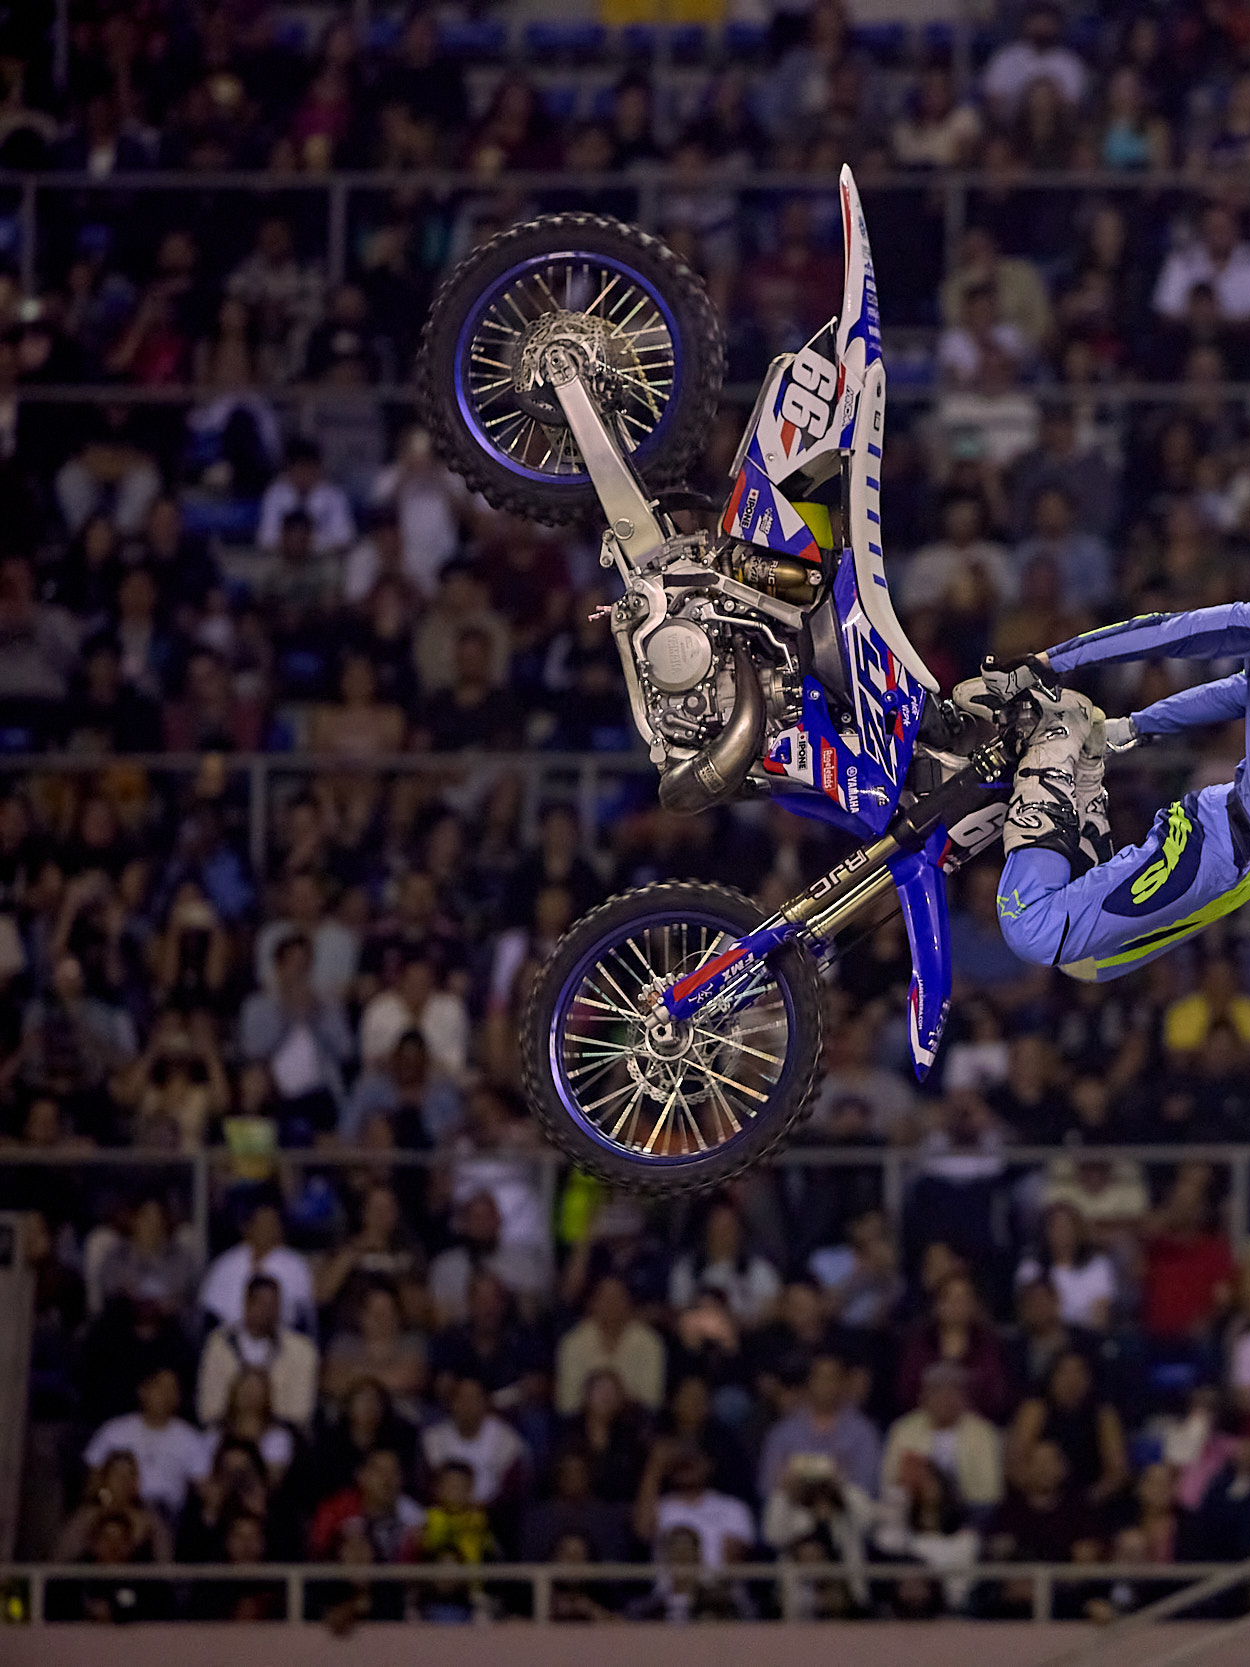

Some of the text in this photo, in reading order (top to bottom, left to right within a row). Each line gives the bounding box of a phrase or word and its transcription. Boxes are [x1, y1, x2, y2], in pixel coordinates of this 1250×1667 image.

[782, 346, 837, 440] 66
[741, 498, 757, 528] IPONE
[768, 560, 778, 585] RJC
[798, 740, 807, 770] IPONE
[846, 776, 860, 814] YAMAHA
[809, 849, 869, 900] RJC
[721, 952, 755, 984] FMX
